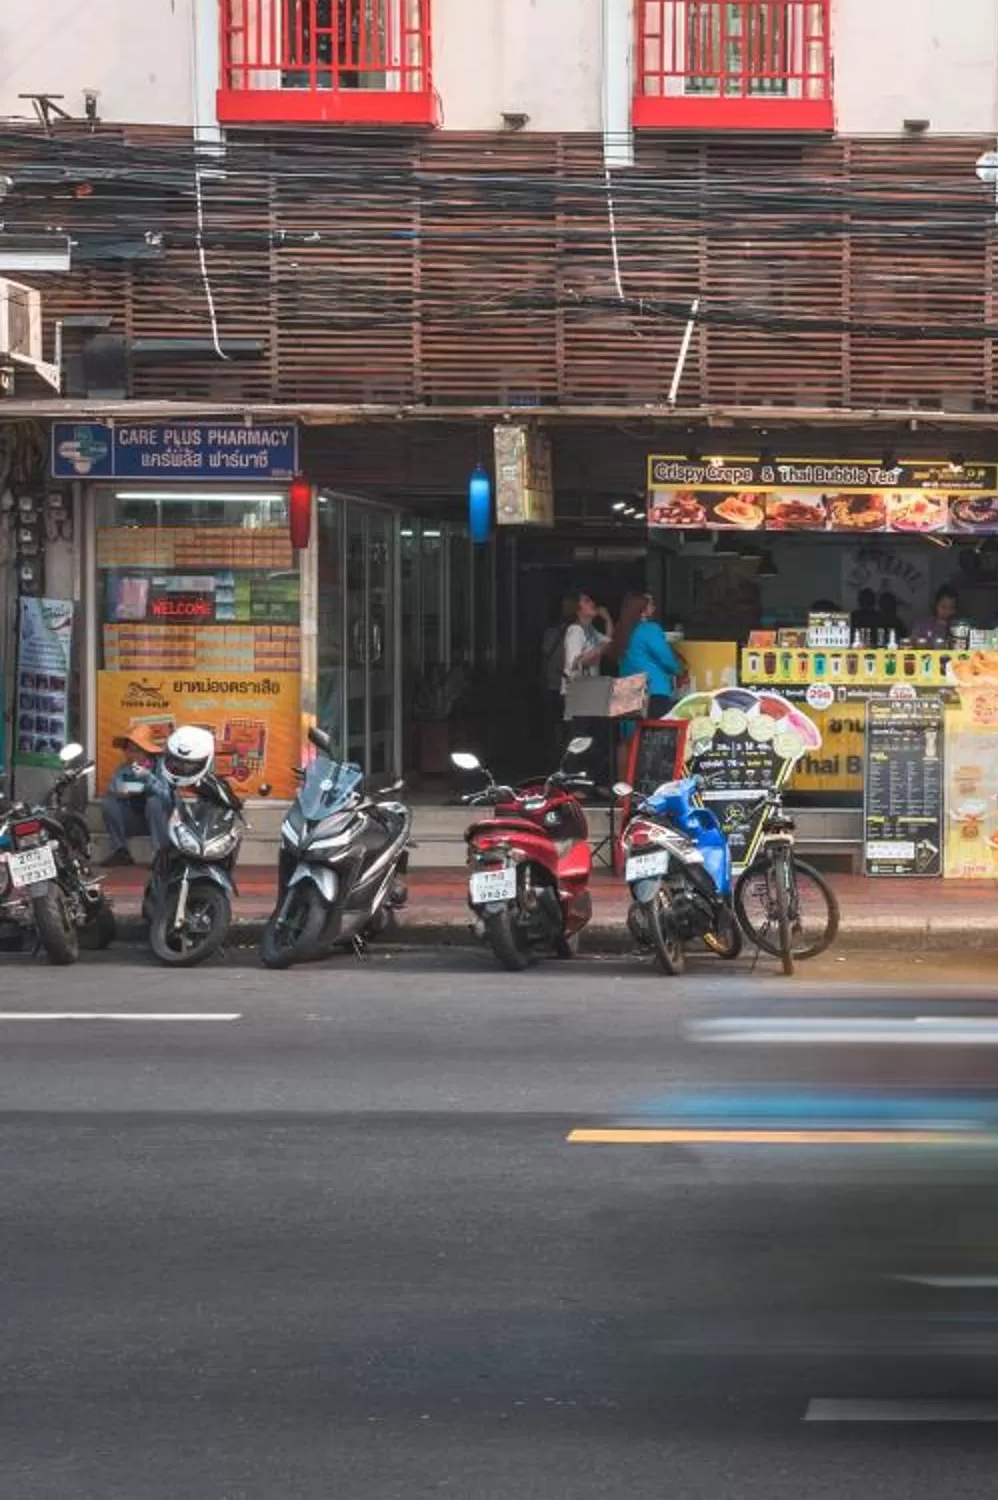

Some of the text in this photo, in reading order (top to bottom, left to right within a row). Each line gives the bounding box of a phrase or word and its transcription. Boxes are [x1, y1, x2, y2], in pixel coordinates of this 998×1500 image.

[118, 429, 289, 447] CARE PLUS PHARMACY
[655, 463, 704, 484] Crispy
[706, 464, 753, 485] Crepe
[761, 465, 775, 482] &
[777, 465, 812, 483] Thai
[813, 466, 867, 484] Bubble
[868, 467, 901, 485] Tea
[152, 601, 212, 616] WELCOME
